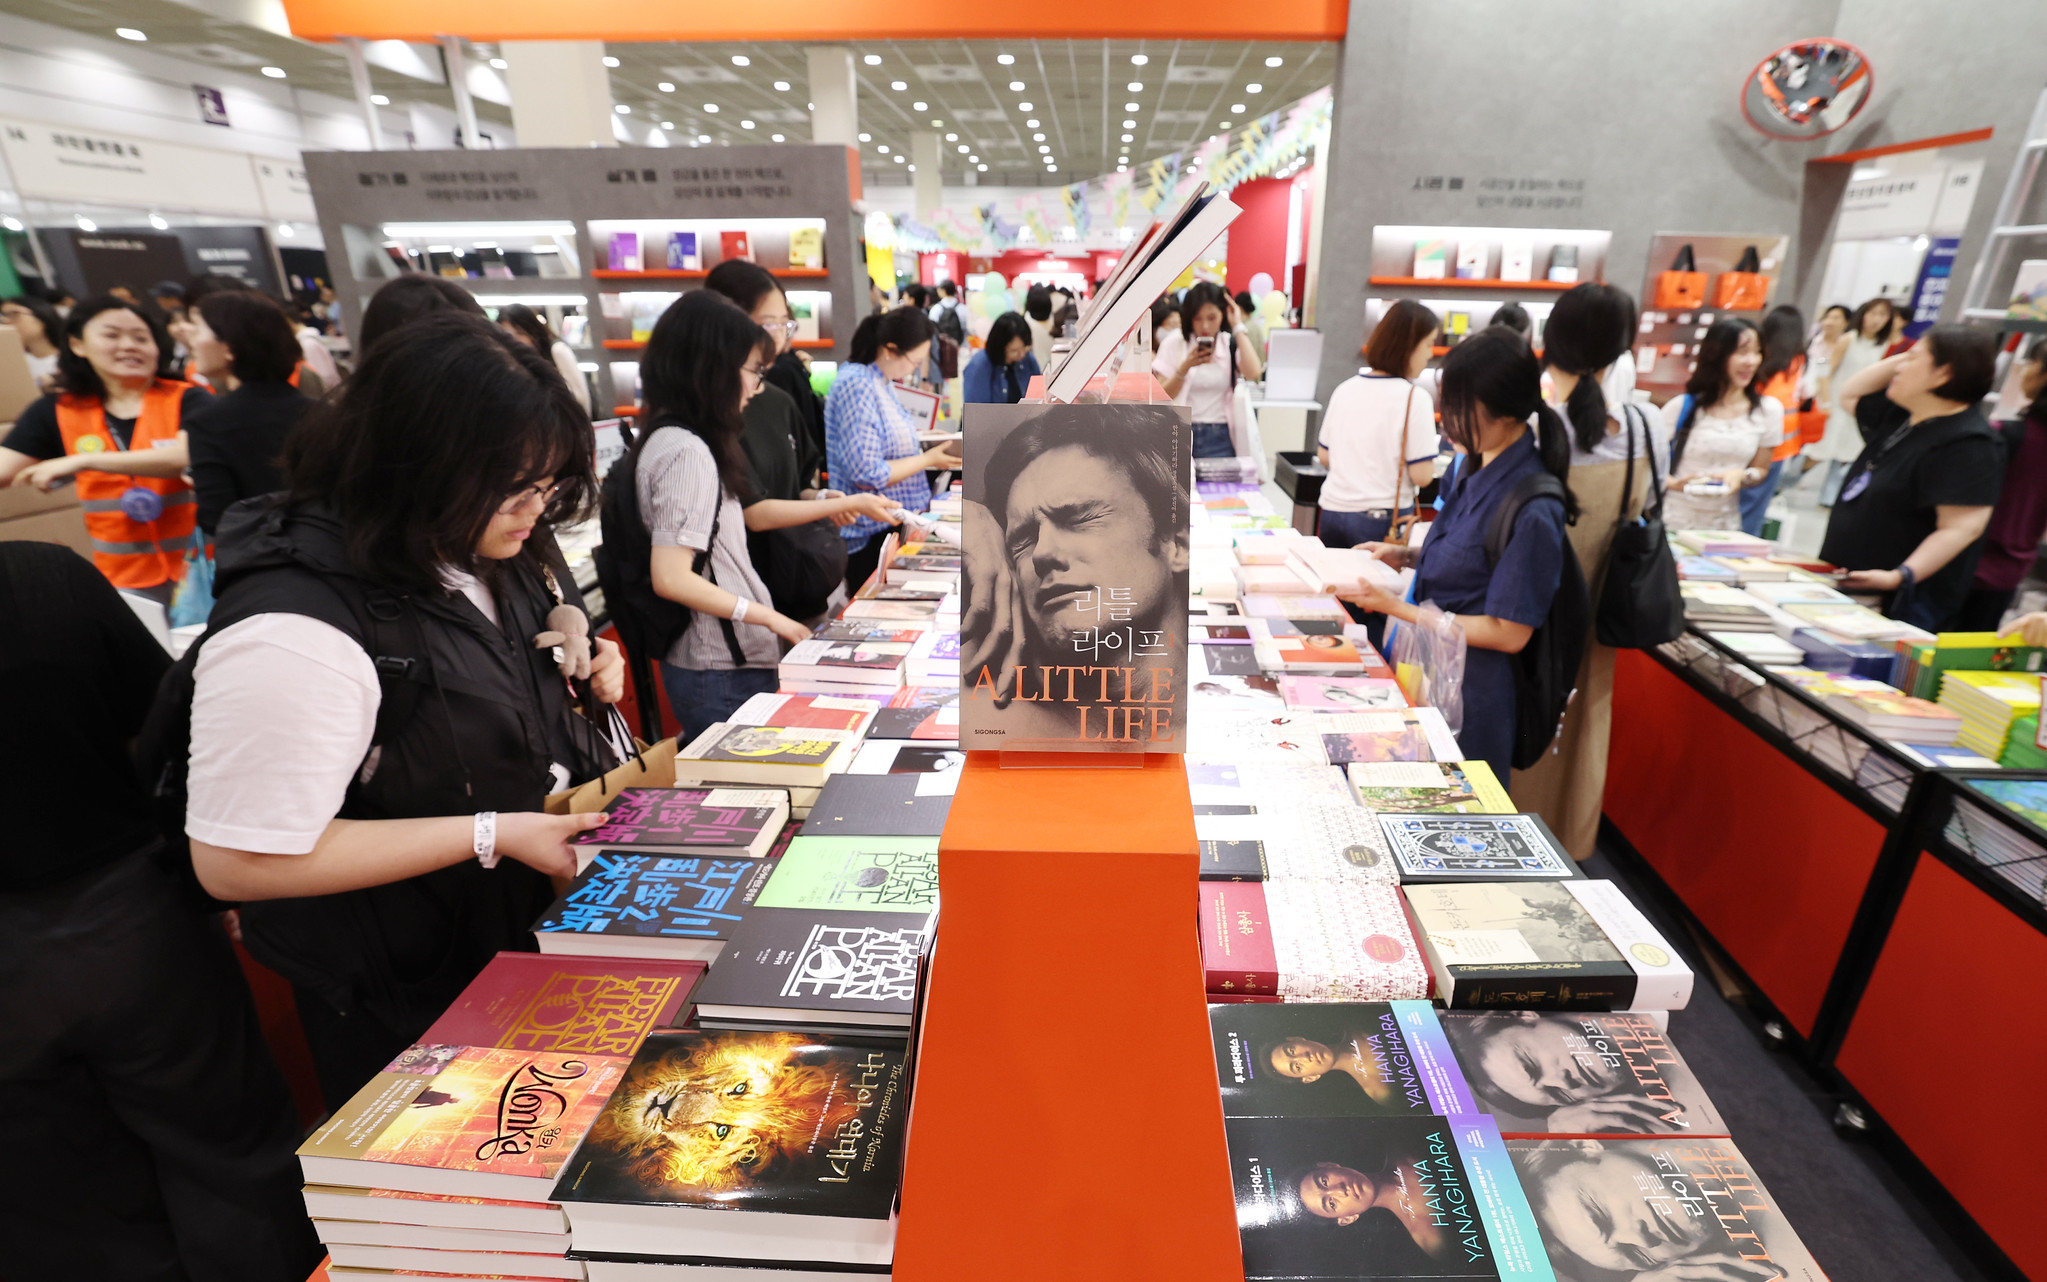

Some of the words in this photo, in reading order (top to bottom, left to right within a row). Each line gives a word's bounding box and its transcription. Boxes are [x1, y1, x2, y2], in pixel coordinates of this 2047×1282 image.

[1074, 585, 1138, 622] 리틀
[1072, 626, 1169, 662] 라이프
[968, 664, 1002, 702] A
[1012, 666, 1175, 704] LITTLE
[1075, 705, 1175, 742] LIFE
[683, 807, 760, 842] 戸川
[1236, 910, 1254, 935] 삼총사
[794, 925, 868, 999] POE
[845, 926, 892, 1001] ALLAN
[512, 974, 605, 1050] POE
[565, 974, 634, 1053] ALLAN
[598, 976, 670, 1054] EDGAR
[1228, 1038, 1245, 1073] 파라다이스
[1366, 1033, 1396, 1084] HANYA
[1378, 1012, 1425, 1108] YANAGIHARA
[1562, 1032, 1594, 1068] 리틀
[1581, 1018, 1622, 1069] 라이프
[1603, 1016, 1675, 1102] LITTLE
[1627, 1013, 1681, 1067] LIFE
[843, 1051, 886, 1113] 나니아
[891, 1064, 904, 1080] The
[1234, 1074, 1246, 1083] 투
[476, 1059, 588, 1162] Wonka
[878, 1080, 899, 1126] Chronicles
[1658, 1106, 1691, 1129] A
[817, 1117, 864, 1185] 연대기
[862, 1138, 882, 1173] Narnia
[875, 1125, 888, 1139] of
[1412, 1159, 1450, 1227] HANYA
[1425, 1131, 1486, 1263] YANAGIHARA
[1632, 1170, 1674, 1217] 리틀
[1659, 1150, 1705, 1218] 라이프
[1675, 1146, 1775, 1264] LITTLE
[1705, 1145, 1772, 1214] LIFE
